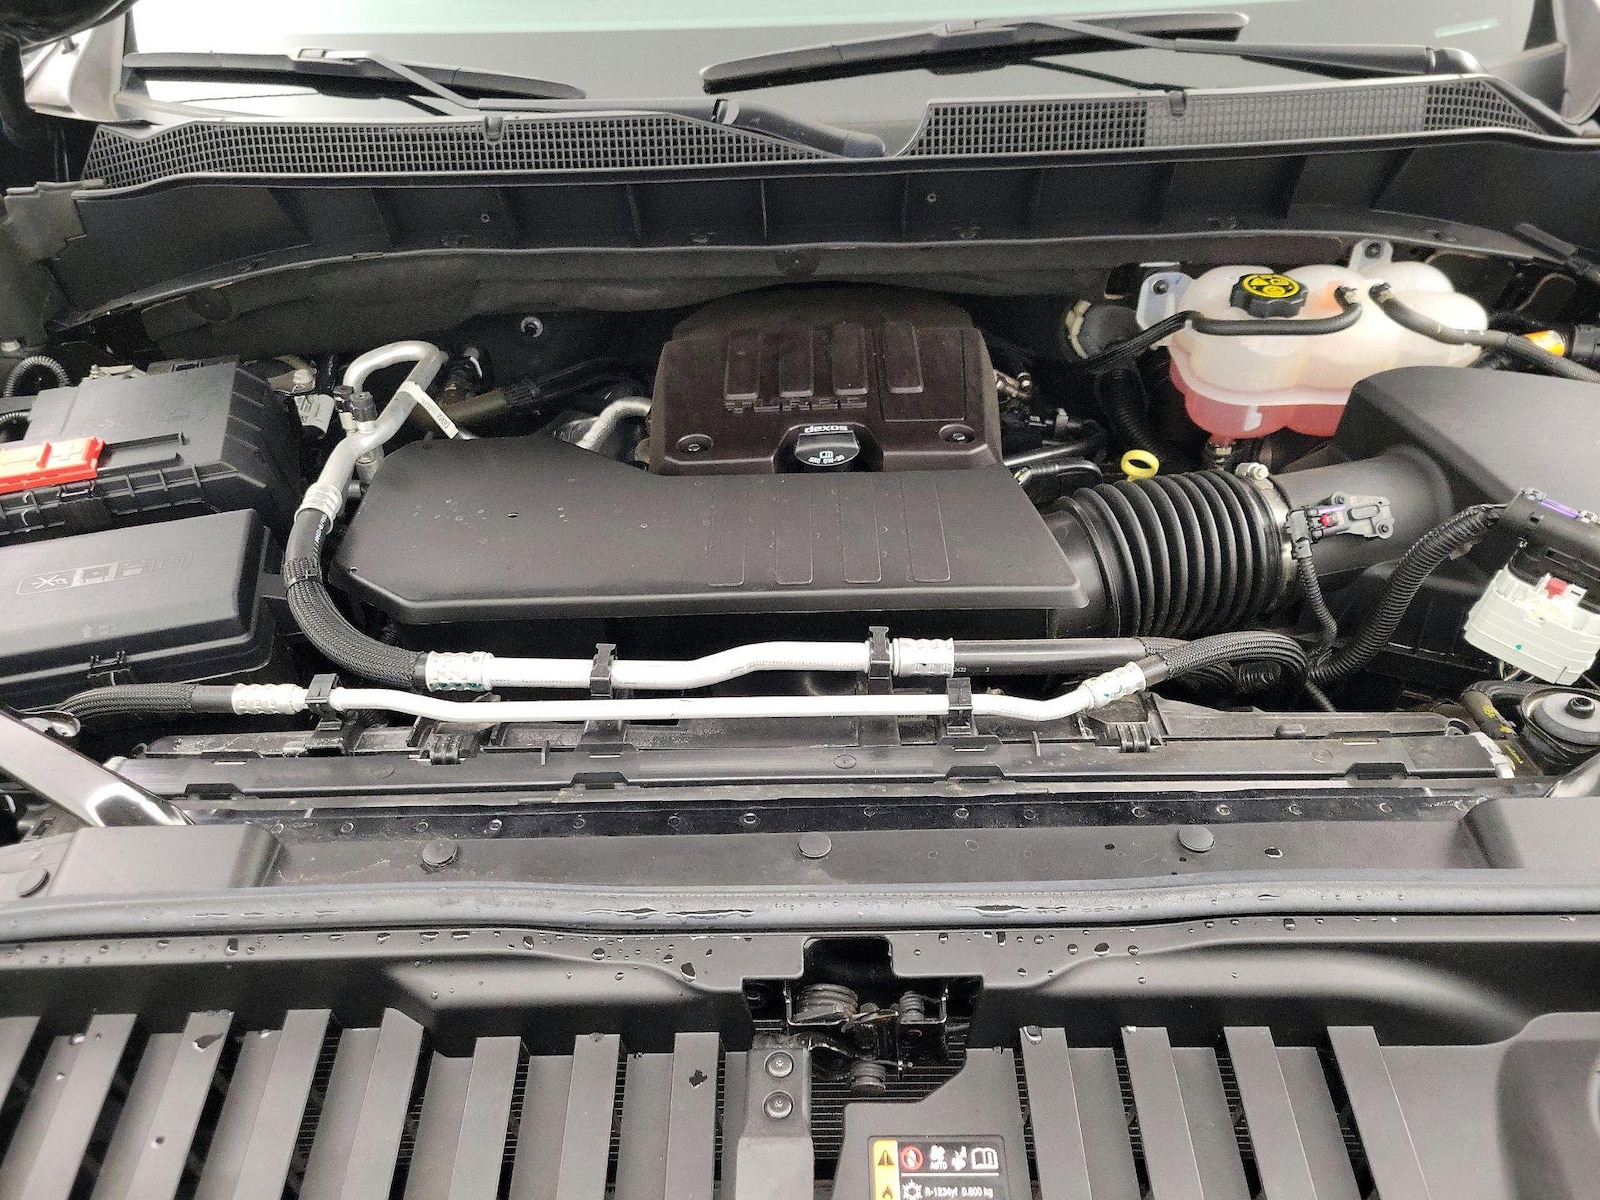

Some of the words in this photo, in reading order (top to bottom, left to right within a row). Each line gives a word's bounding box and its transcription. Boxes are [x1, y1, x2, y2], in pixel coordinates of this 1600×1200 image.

[804, 425, 848, 433] dexos
[930, 1161, 948, 1171] AUTO
[983, 1186, 994, 1199] kg
